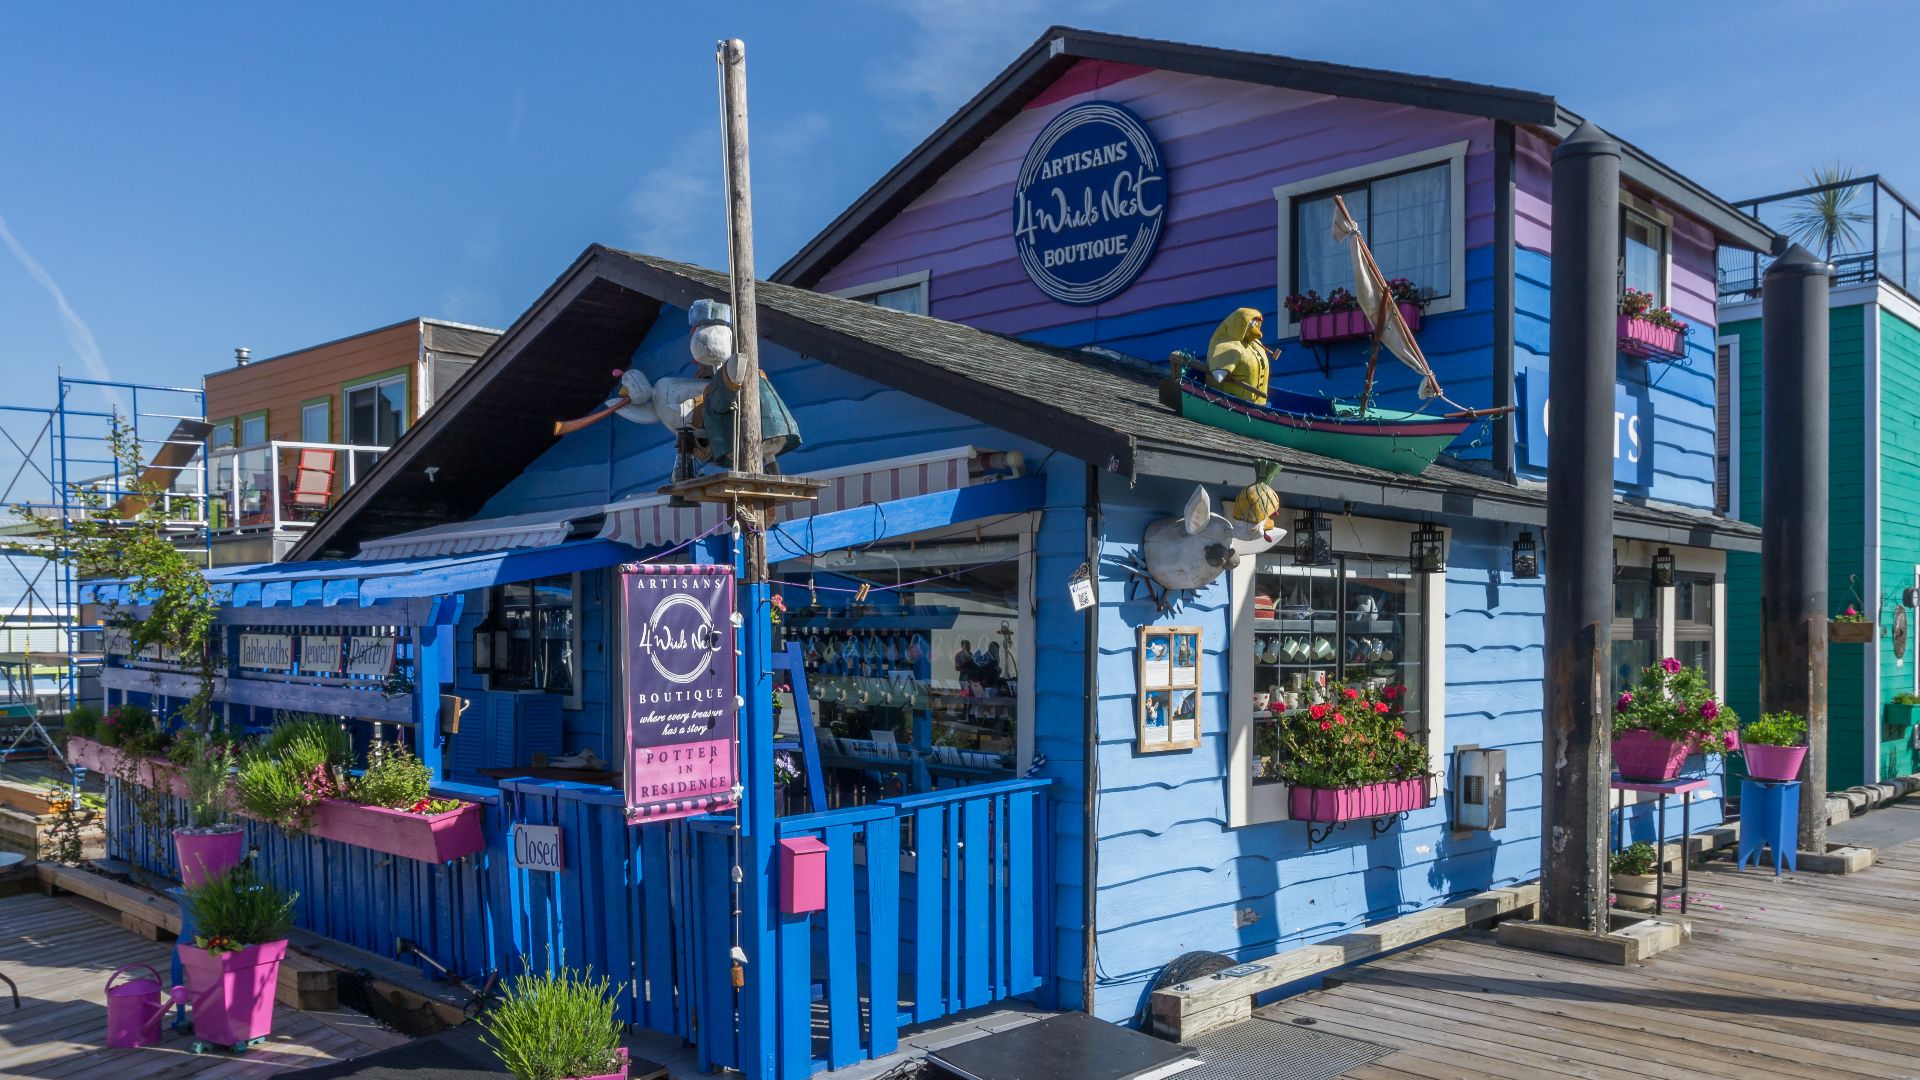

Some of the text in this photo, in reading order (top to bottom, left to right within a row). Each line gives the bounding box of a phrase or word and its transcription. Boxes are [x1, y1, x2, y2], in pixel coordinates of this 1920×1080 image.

[1041, 141, 1128, 180] ARTISANS
[1015, 165, 1162, 245] 4 Winds Nest
[1044, 234, 1129, 268] BOUTIQUE
[637, 578, 721, 589] ARTISANS
[241, 636, 289, 665] Tablecloths
[302, 636, 338, 670] Jewelry
[639, 623, 722, 654] 4 Winds Nest
[352, 638, 391, 671] Pottery
[639, 688, 723, 704] BOUTIQUE
[640, 709, 723, 723] where every treasure
[662, 723, 677, 735] has
[687, 723, 708, 735] story
[646, 746, 718, 765] POTTER
[678, 764, 693, 774] IN
[641, 777, 726, 798] RESIDENCE
[514, 826, 560, 868] Closed
